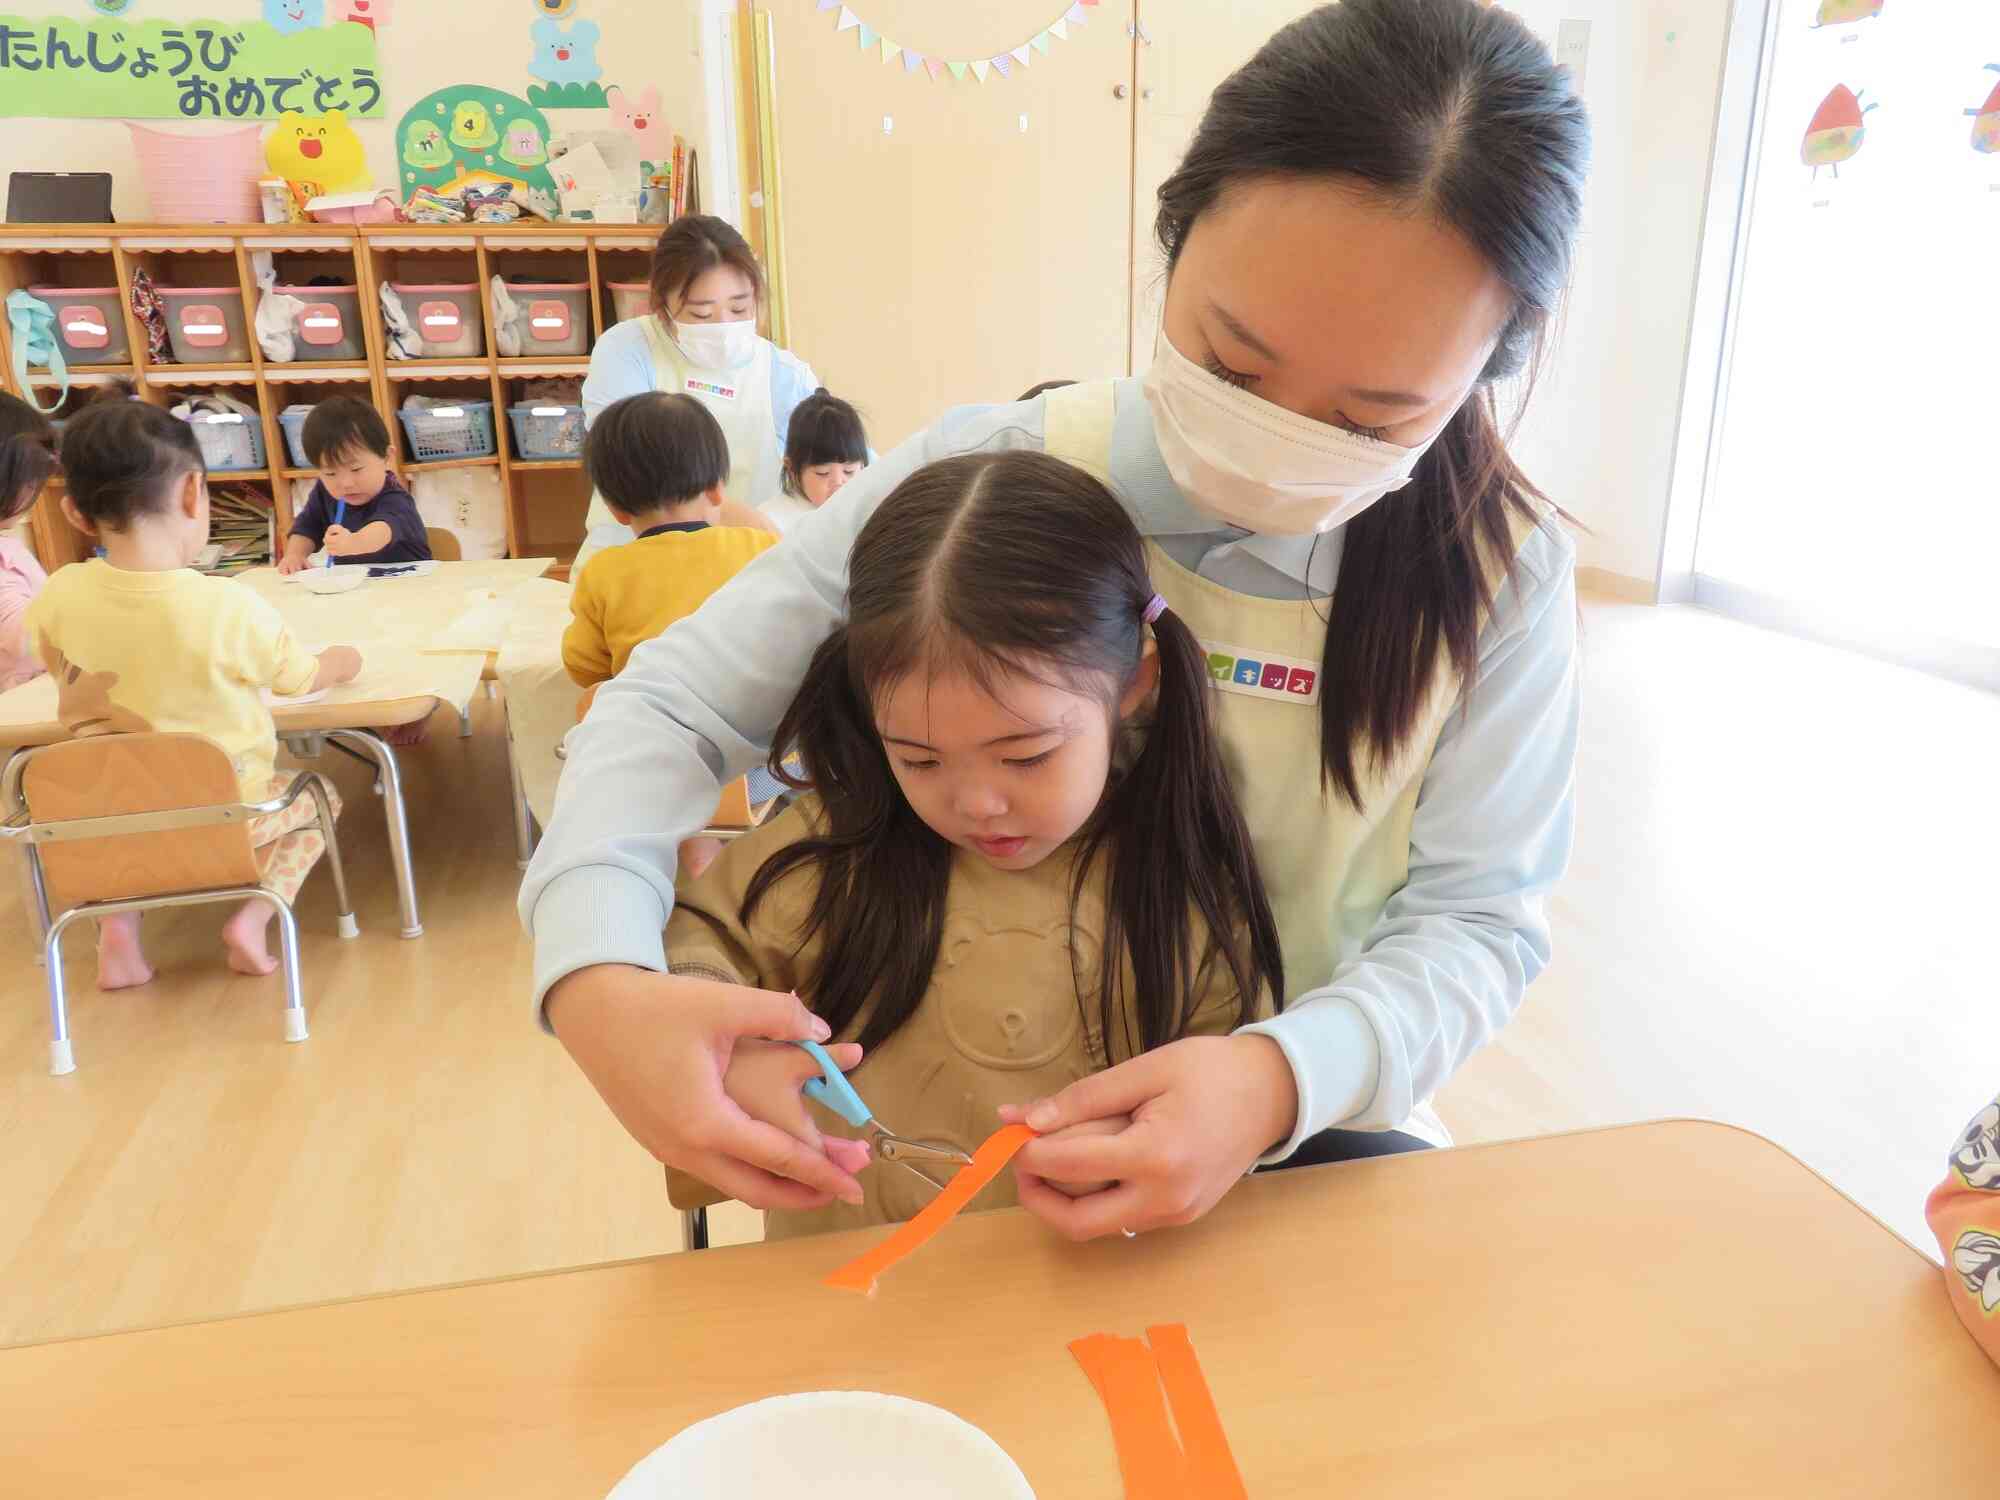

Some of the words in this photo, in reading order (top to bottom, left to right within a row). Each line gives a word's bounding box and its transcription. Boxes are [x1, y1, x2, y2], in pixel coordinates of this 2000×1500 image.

[0, 25, 245, 78] たんじょうび
[177, 69, 381, 116] おめでとう
[463, 119, 475, 131] 4
[1212, 664, 1314, 694] イキッズ
